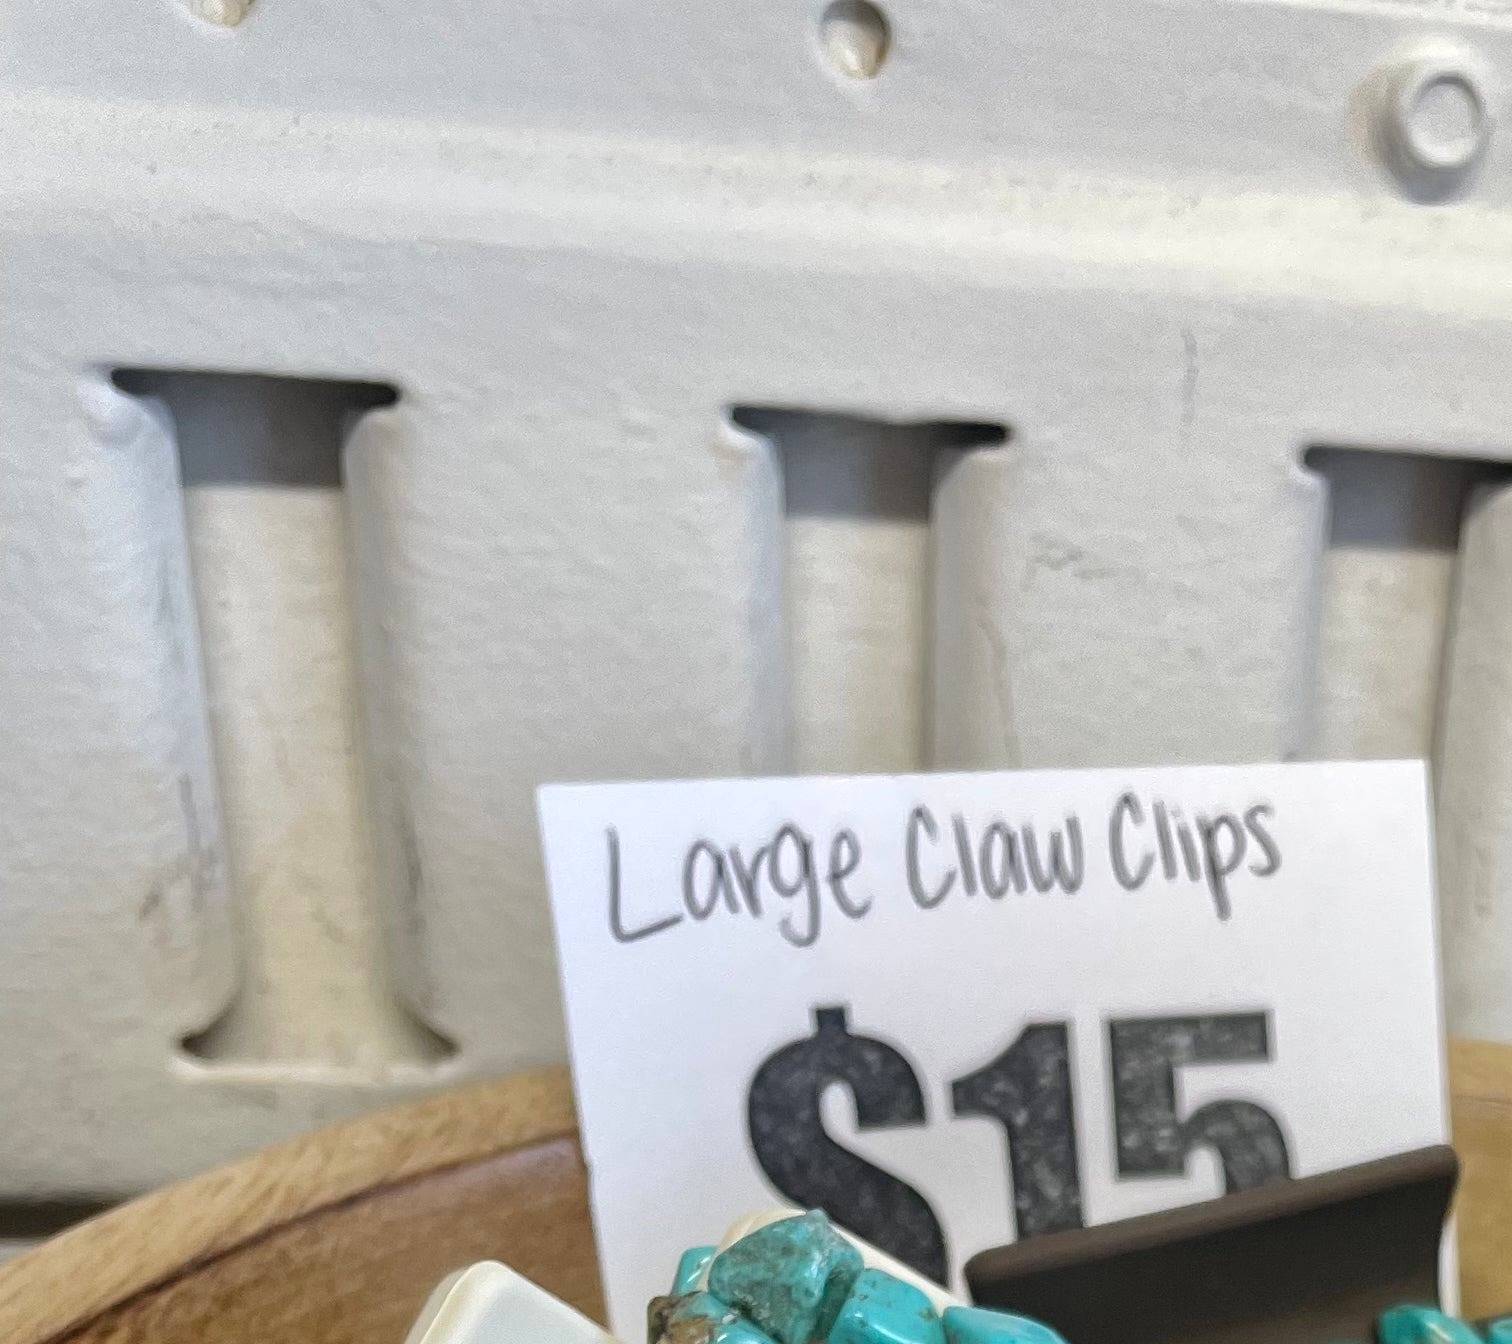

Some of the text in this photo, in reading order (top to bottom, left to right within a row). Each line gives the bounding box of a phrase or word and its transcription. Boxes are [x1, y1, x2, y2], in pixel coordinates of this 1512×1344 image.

[606, 792, 1282, 949] Large Claw Clips
[746, 1003, 1297, 1287] $15
